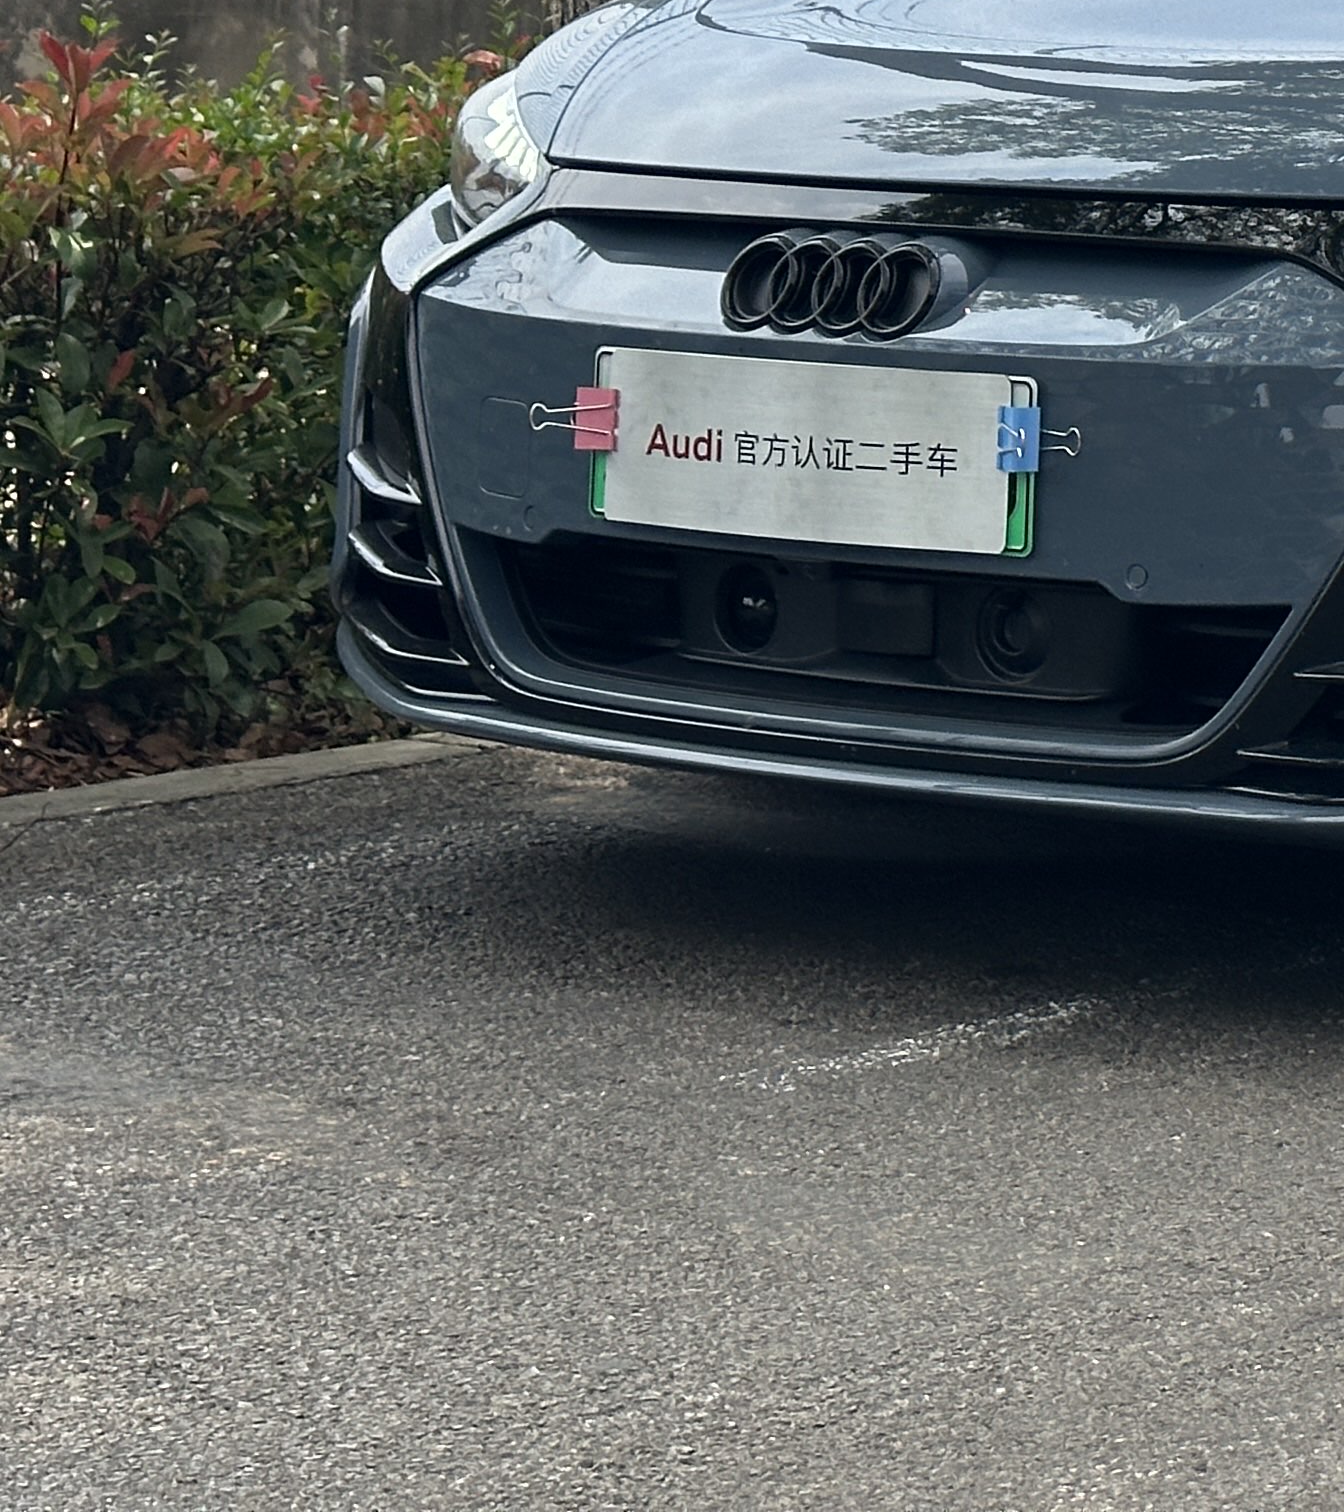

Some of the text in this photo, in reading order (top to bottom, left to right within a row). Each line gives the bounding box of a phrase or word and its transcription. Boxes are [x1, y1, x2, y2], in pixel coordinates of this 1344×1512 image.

[646, 423, 959, 478] Audi 官方认证二手车
